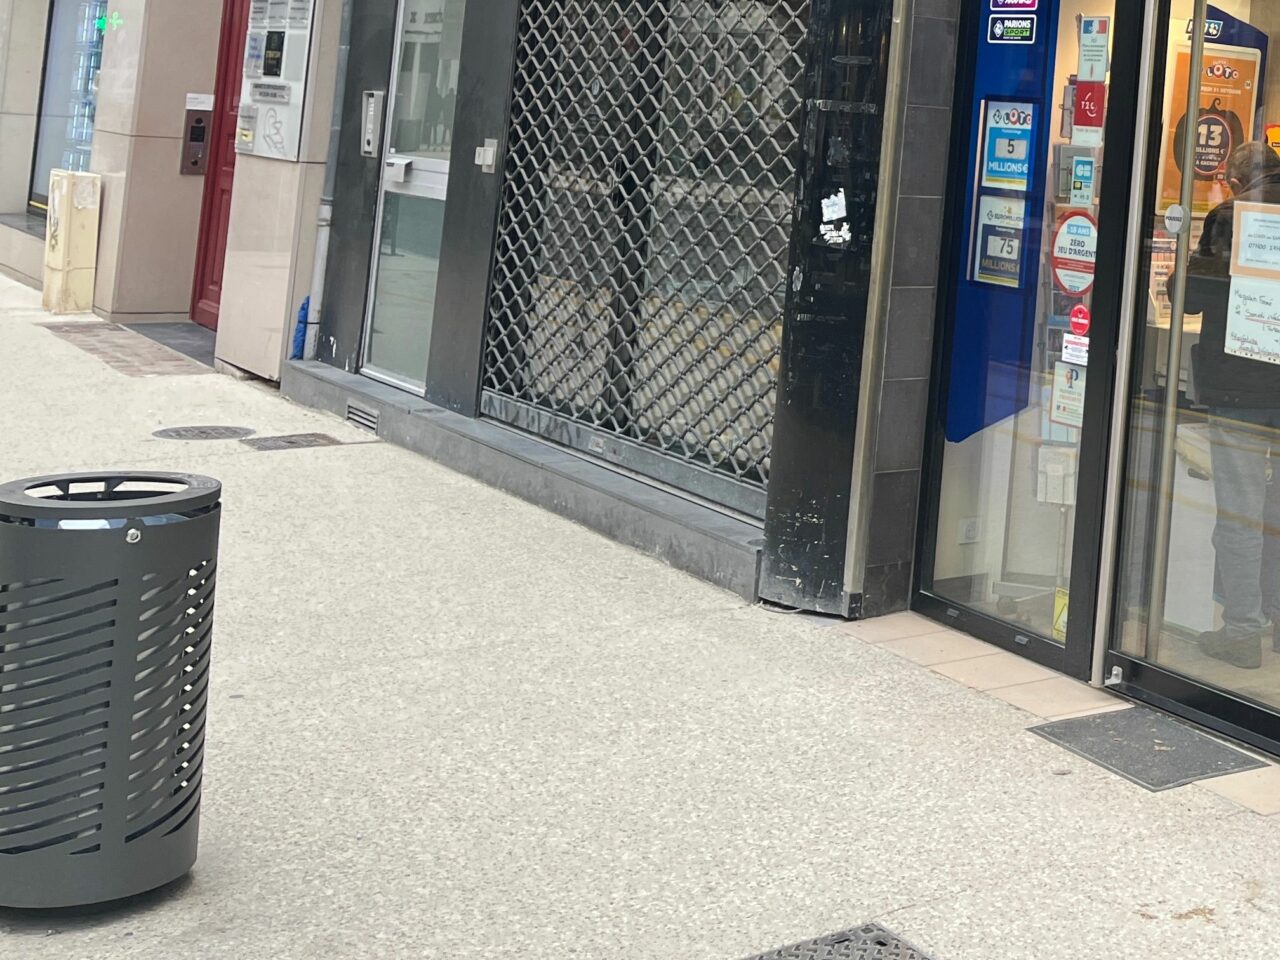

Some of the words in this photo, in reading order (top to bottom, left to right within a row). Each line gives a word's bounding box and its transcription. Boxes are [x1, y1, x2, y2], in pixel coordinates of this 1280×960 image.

[1004, 20, 1031, 28] PARIONS
[1206, 64, 1239, 79] LOTO
[1198, 124, 1223, 146] 13
[1007, 138, 1015, 155] 5
[1000, 237, 1014, 255] 75
